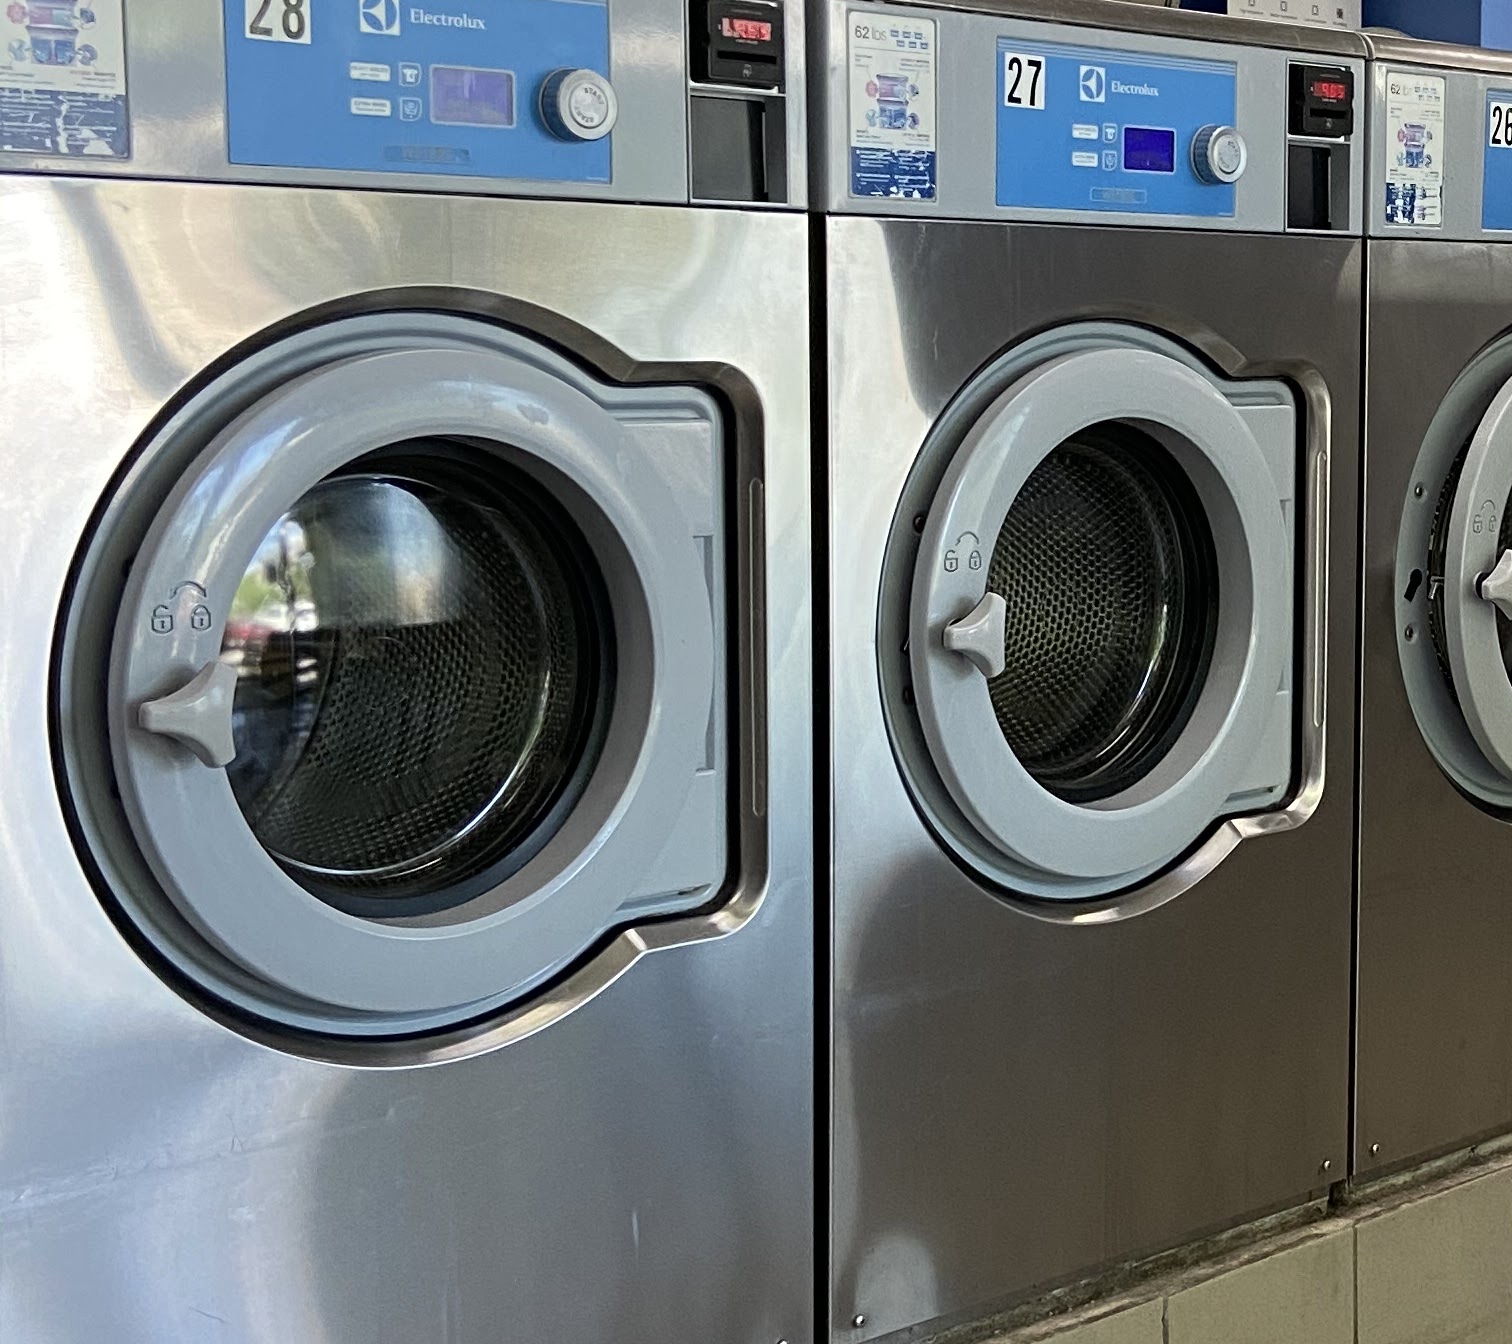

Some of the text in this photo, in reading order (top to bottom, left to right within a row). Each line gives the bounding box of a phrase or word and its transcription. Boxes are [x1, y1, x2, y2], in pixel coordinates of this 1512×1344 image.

[410, 8, 487, 31] Electrolux
[854, 25, 870, 40] 62
[1007, 56, 1042, 106] 27
[1111, 80, 1159, 97] Electrolux
[1390, 83, 1401, 95] 62
